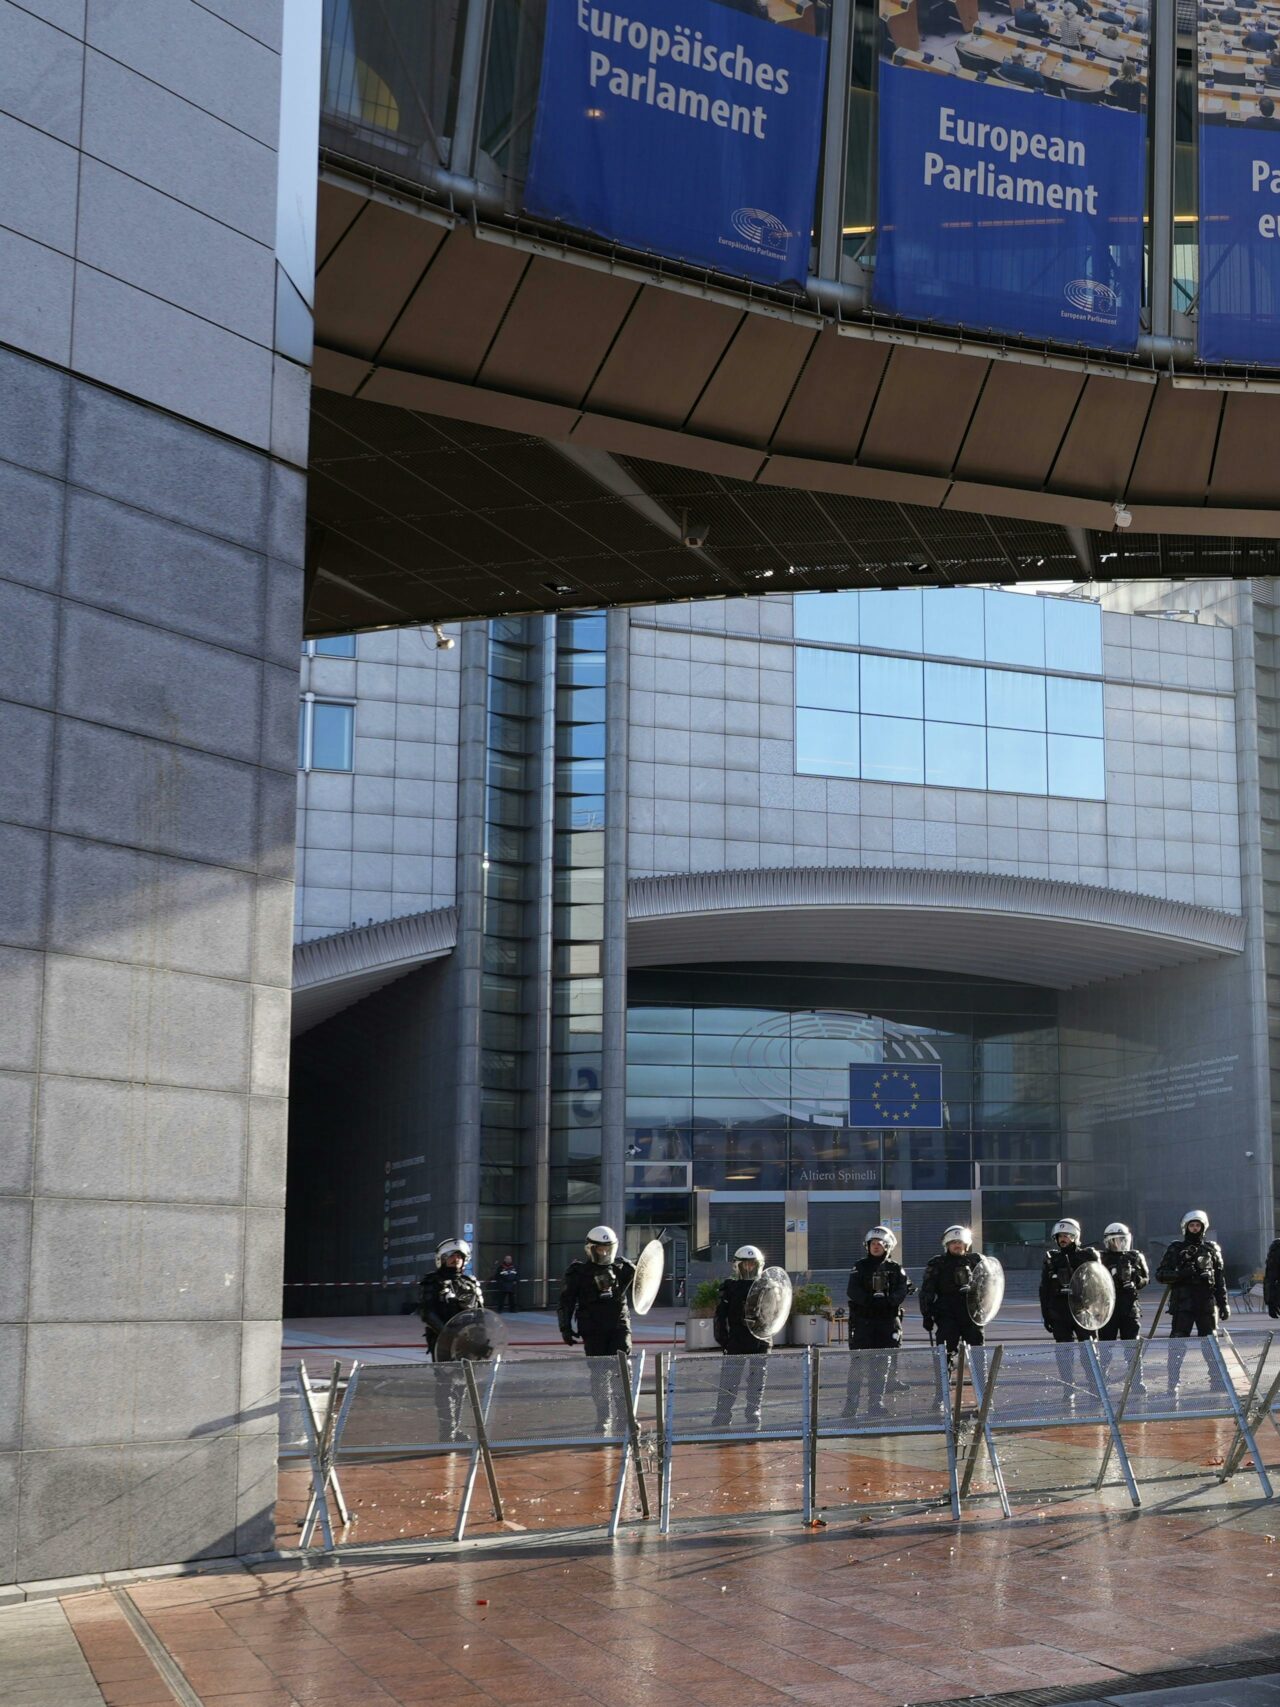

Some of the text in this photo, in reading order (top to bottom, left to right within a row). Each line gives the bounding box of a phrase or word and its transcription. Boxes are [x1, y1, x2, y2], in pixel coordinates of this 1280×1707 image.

[578, 0, 789, 95] Europäisches
[590, 51, 767, 139] Parlament
[939, 106, 1085, 167] European
[924, 152, 1098, 215] Parliament
[757, 247, 787, 261] Parlament
[1061, 310, 1087, 320] European
[800, 1169, 877, 1183] Altiero Spinelli
